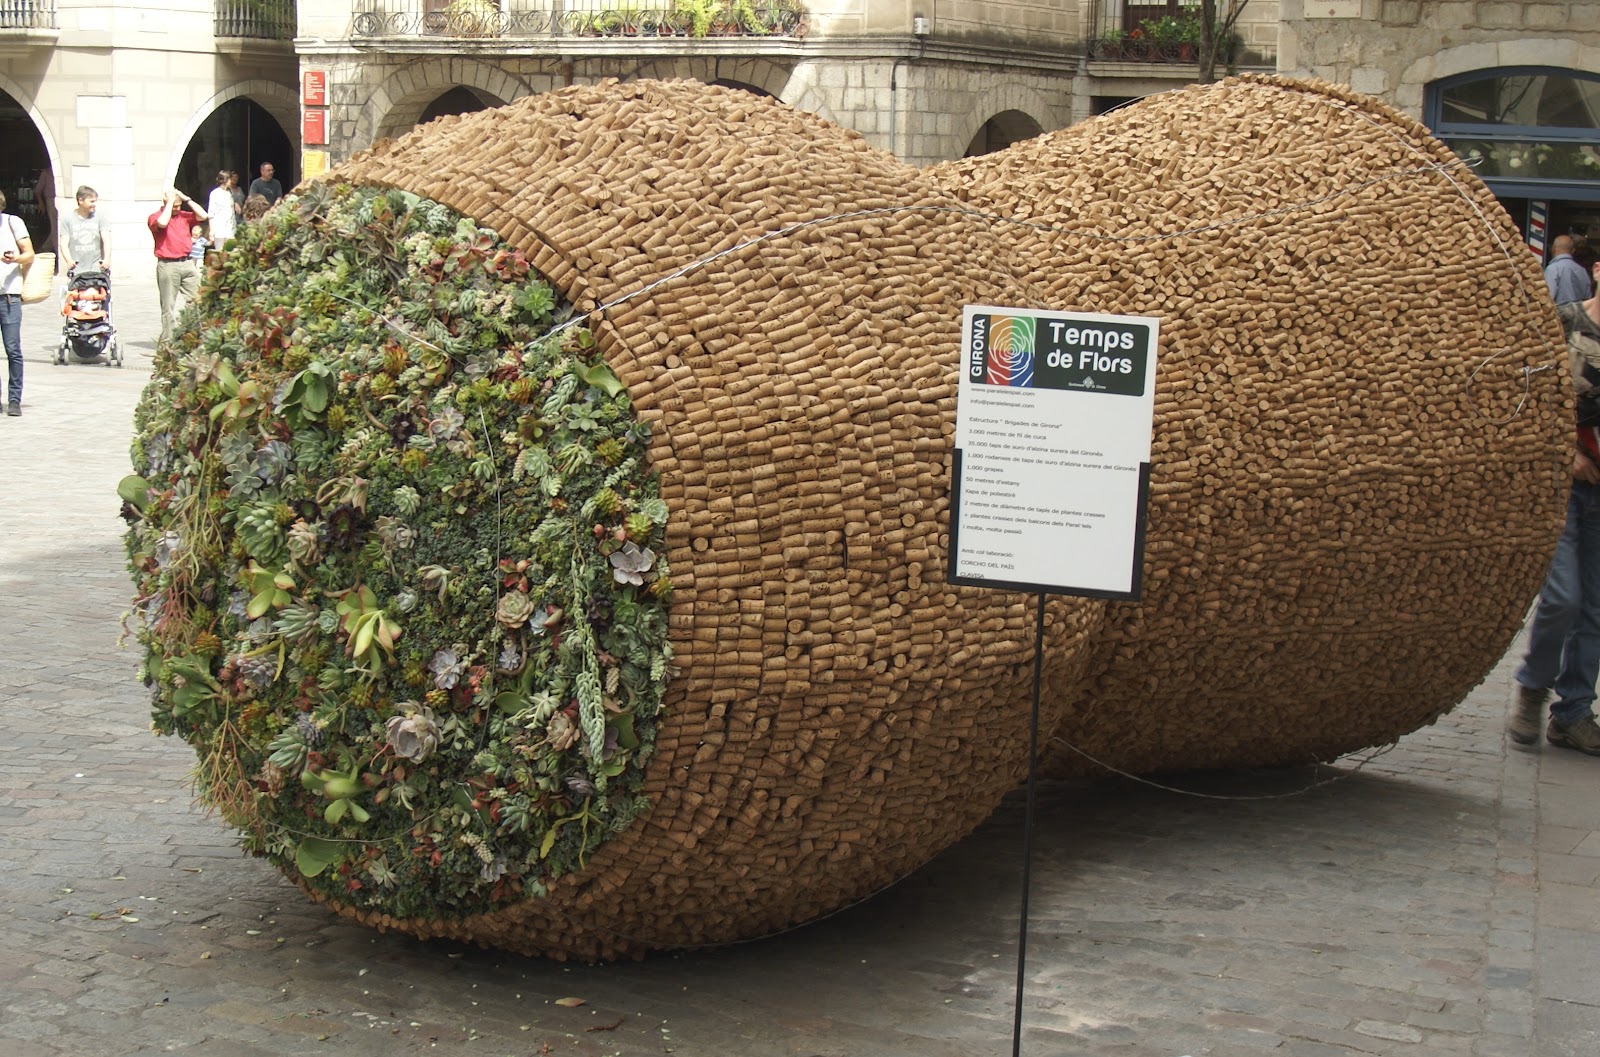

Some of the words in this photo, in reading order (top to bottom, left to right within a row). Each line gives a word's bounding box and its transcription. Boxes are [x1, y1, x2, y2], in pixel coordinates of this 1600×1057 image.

[971, 318, 986, 377] GIRONA
[1049, 322, 1134, 353] Temps
[1047, 349, 1073, 368] de
[1079, 351, 1132, 374] Flors
